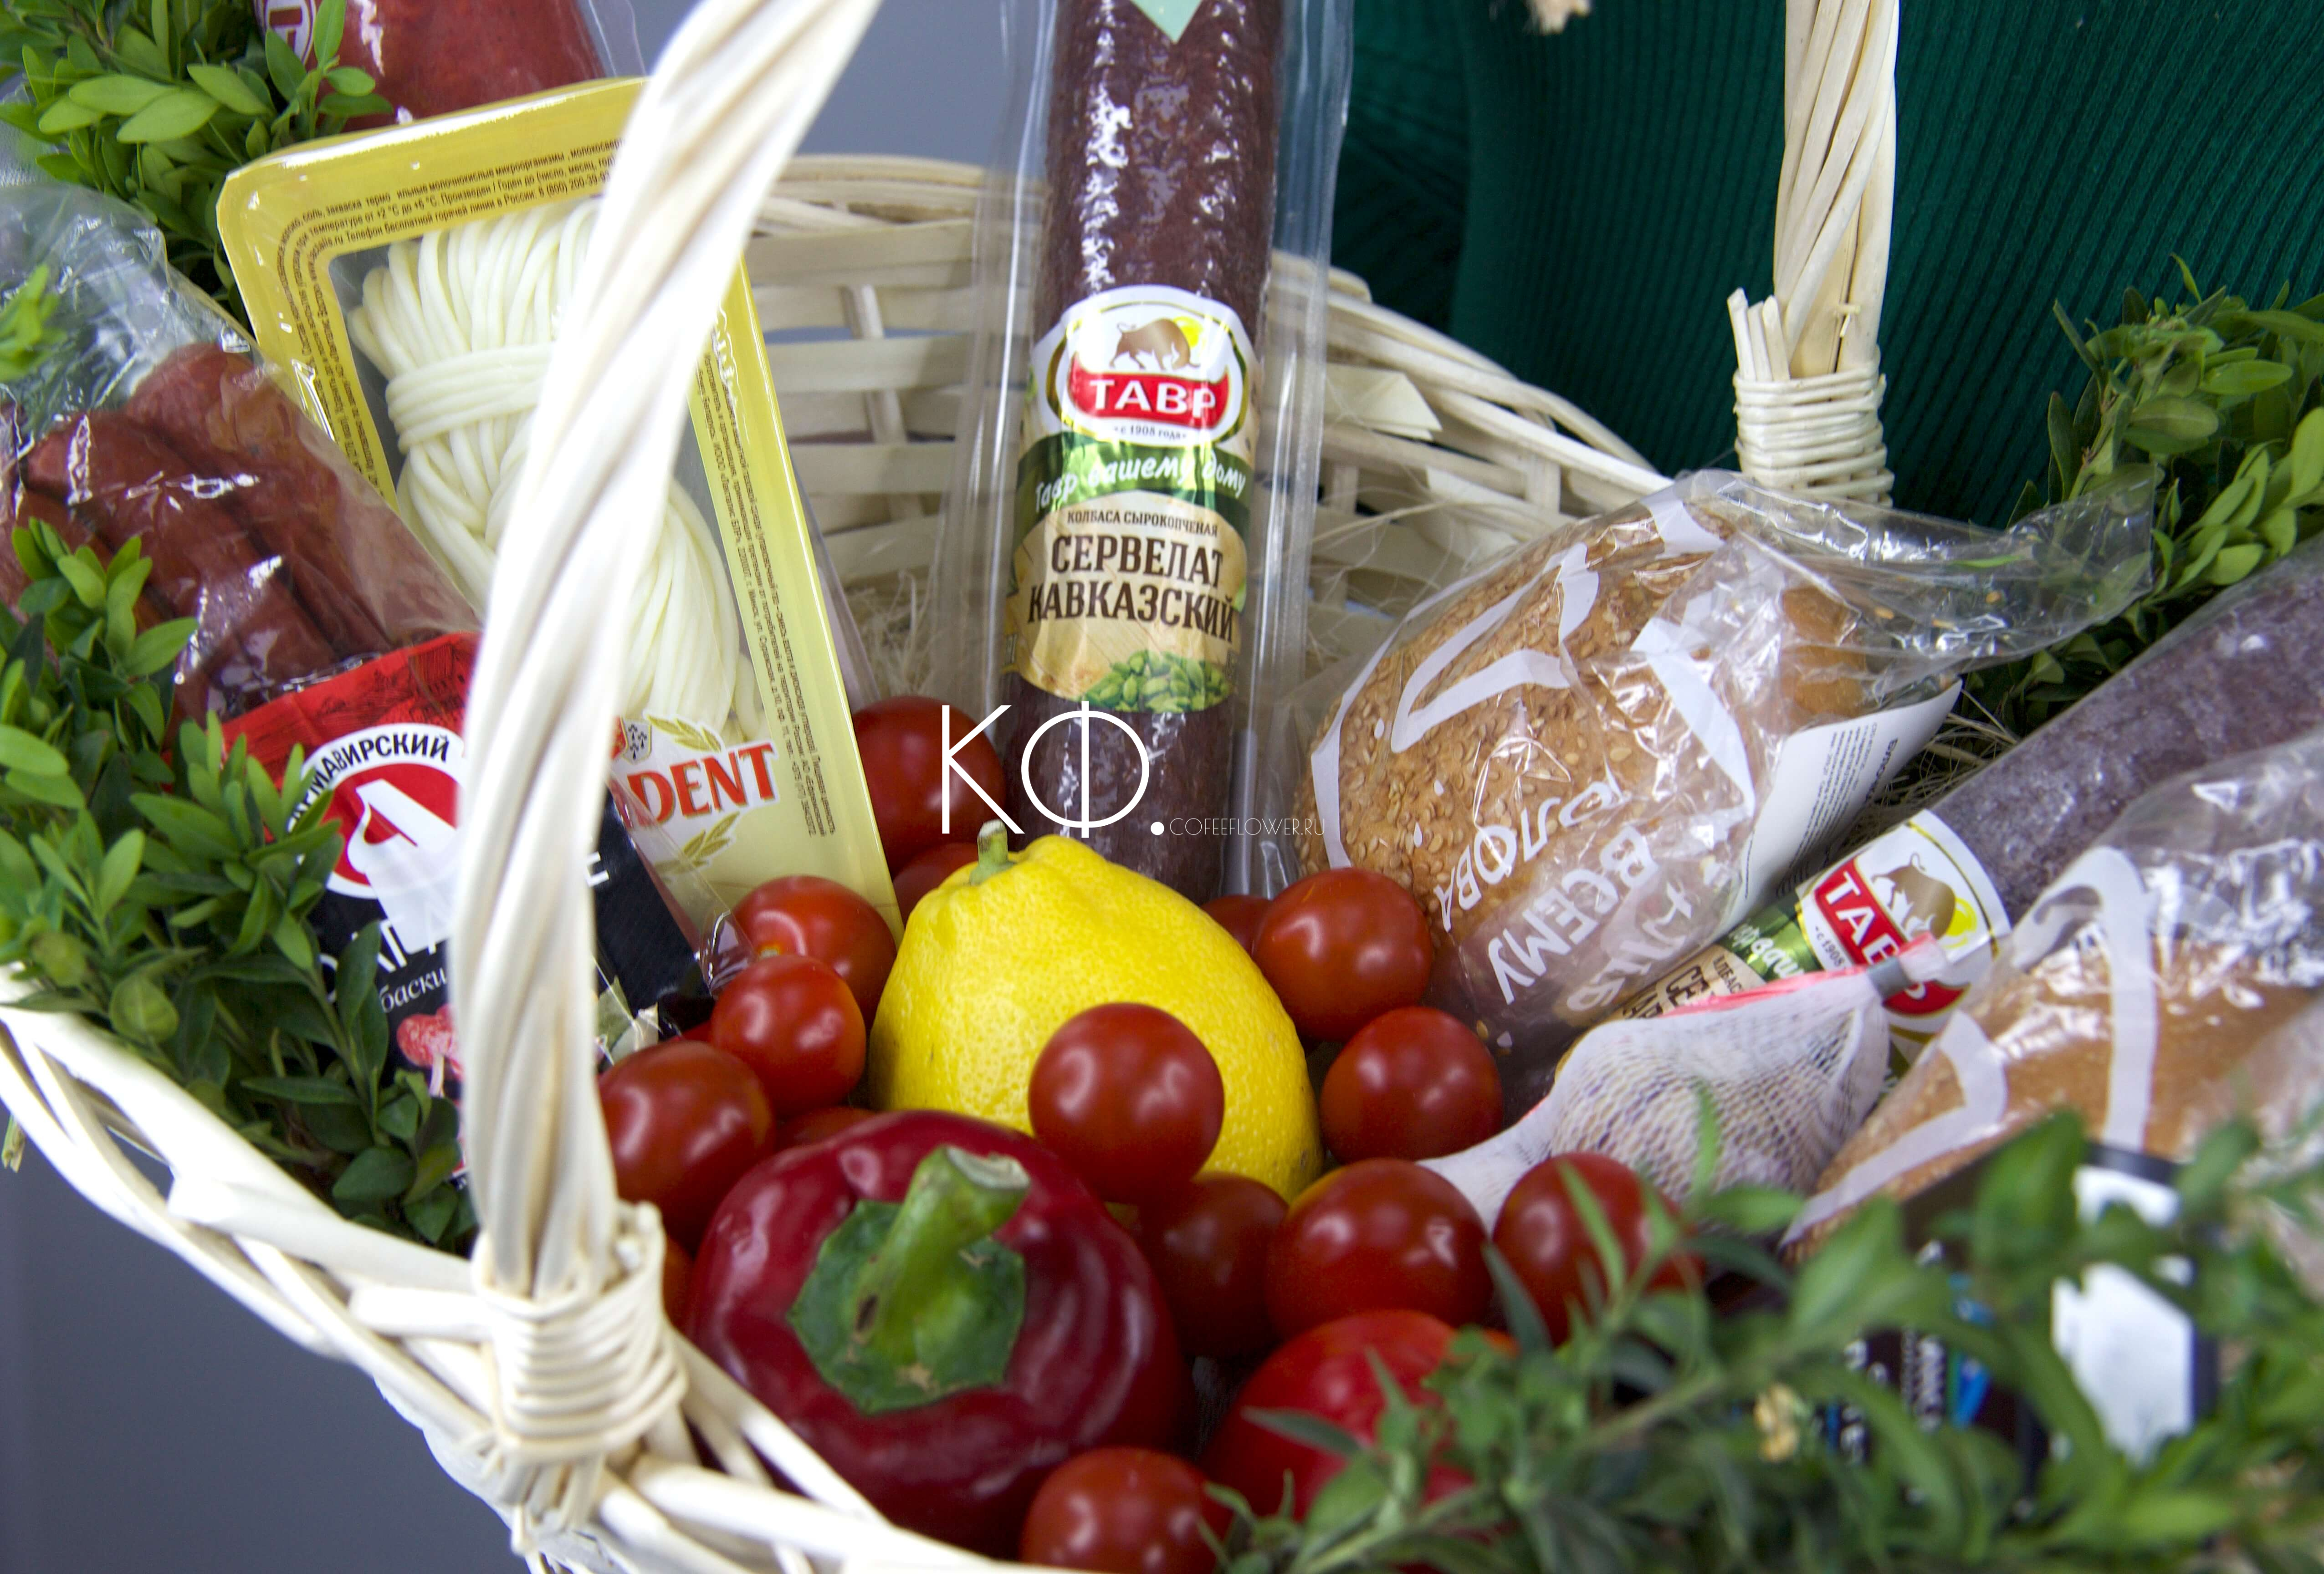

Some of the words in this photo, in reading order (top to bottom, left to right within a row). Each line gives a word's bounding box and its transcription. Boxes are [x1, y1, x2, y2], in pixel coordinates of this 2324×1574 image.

[309, 216, 363, 235] температуре
[364, 211, 374, 221] от
[401, 204, 412, 215] до
[441, 186, 491, 204] Произведен
[497, 179, 522, 191] Годен
[524, 175, 535, 187] до
[326, 199, 362, 215] закваска
[429, 169, 494, 191] молочнокислые
[495, 153, 564, 175] микроорганизмы
[346, 226, 383, 242] Телефон
[384, 214, 433, 233] бесплатной
[435, 205, 468, 221] горячей
[470, 200, 495, 214] линии
[1090, 379, 1216, 418] ТАВР
[1131, 424, 1155, 436] 1908
[1158, 429, 1181, 440] года
[1087, 455, 1195, 487] вашему
[1203, 451, 1246, 499] дому
[1067, 510, 1121, 525] КОЛБАСА
[1123, 510, 1218, 538] СЫРОКОПЧЕНАЯ
[1051, 534, 1223, 589] СЕРВЕЛАТ
[1027, 579, 1234, 644] КАВКАЗСКИЙ
[626, 741, 776, 827] DENT
[1488, 825, 1659, 1005] ВСЕМУ
[379, 967, 448, 1013] баски
